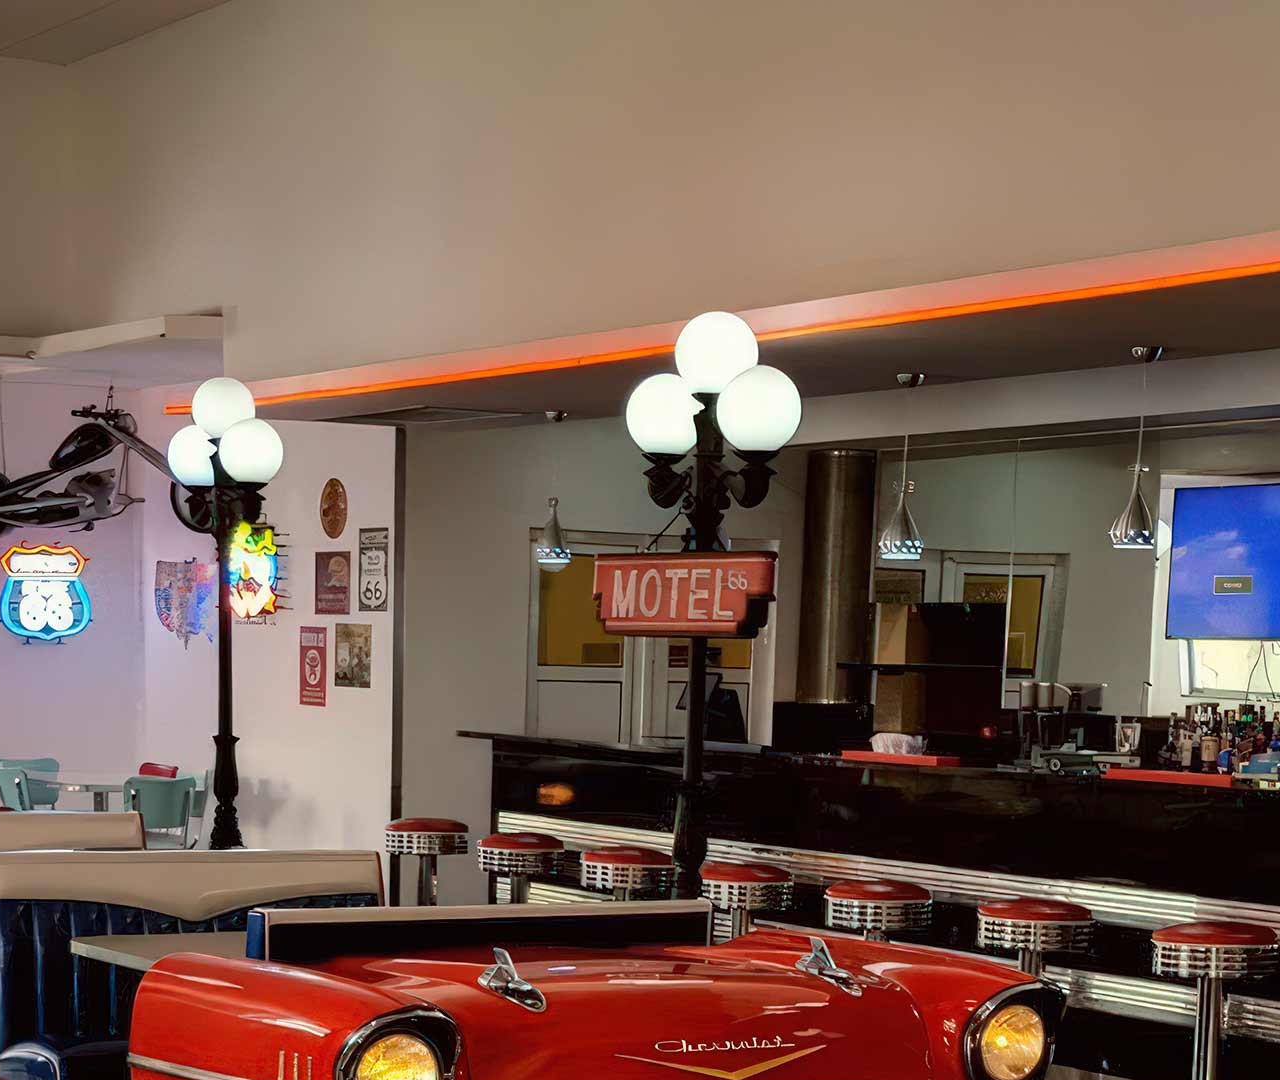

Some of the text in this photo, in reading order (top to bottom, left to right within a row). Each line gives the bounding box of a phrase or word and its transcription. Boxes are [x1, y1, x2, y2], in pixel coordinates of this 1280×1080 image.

[362, 580, 382, 601] 66
[611, 568, 748, 621] MOTEL 66
